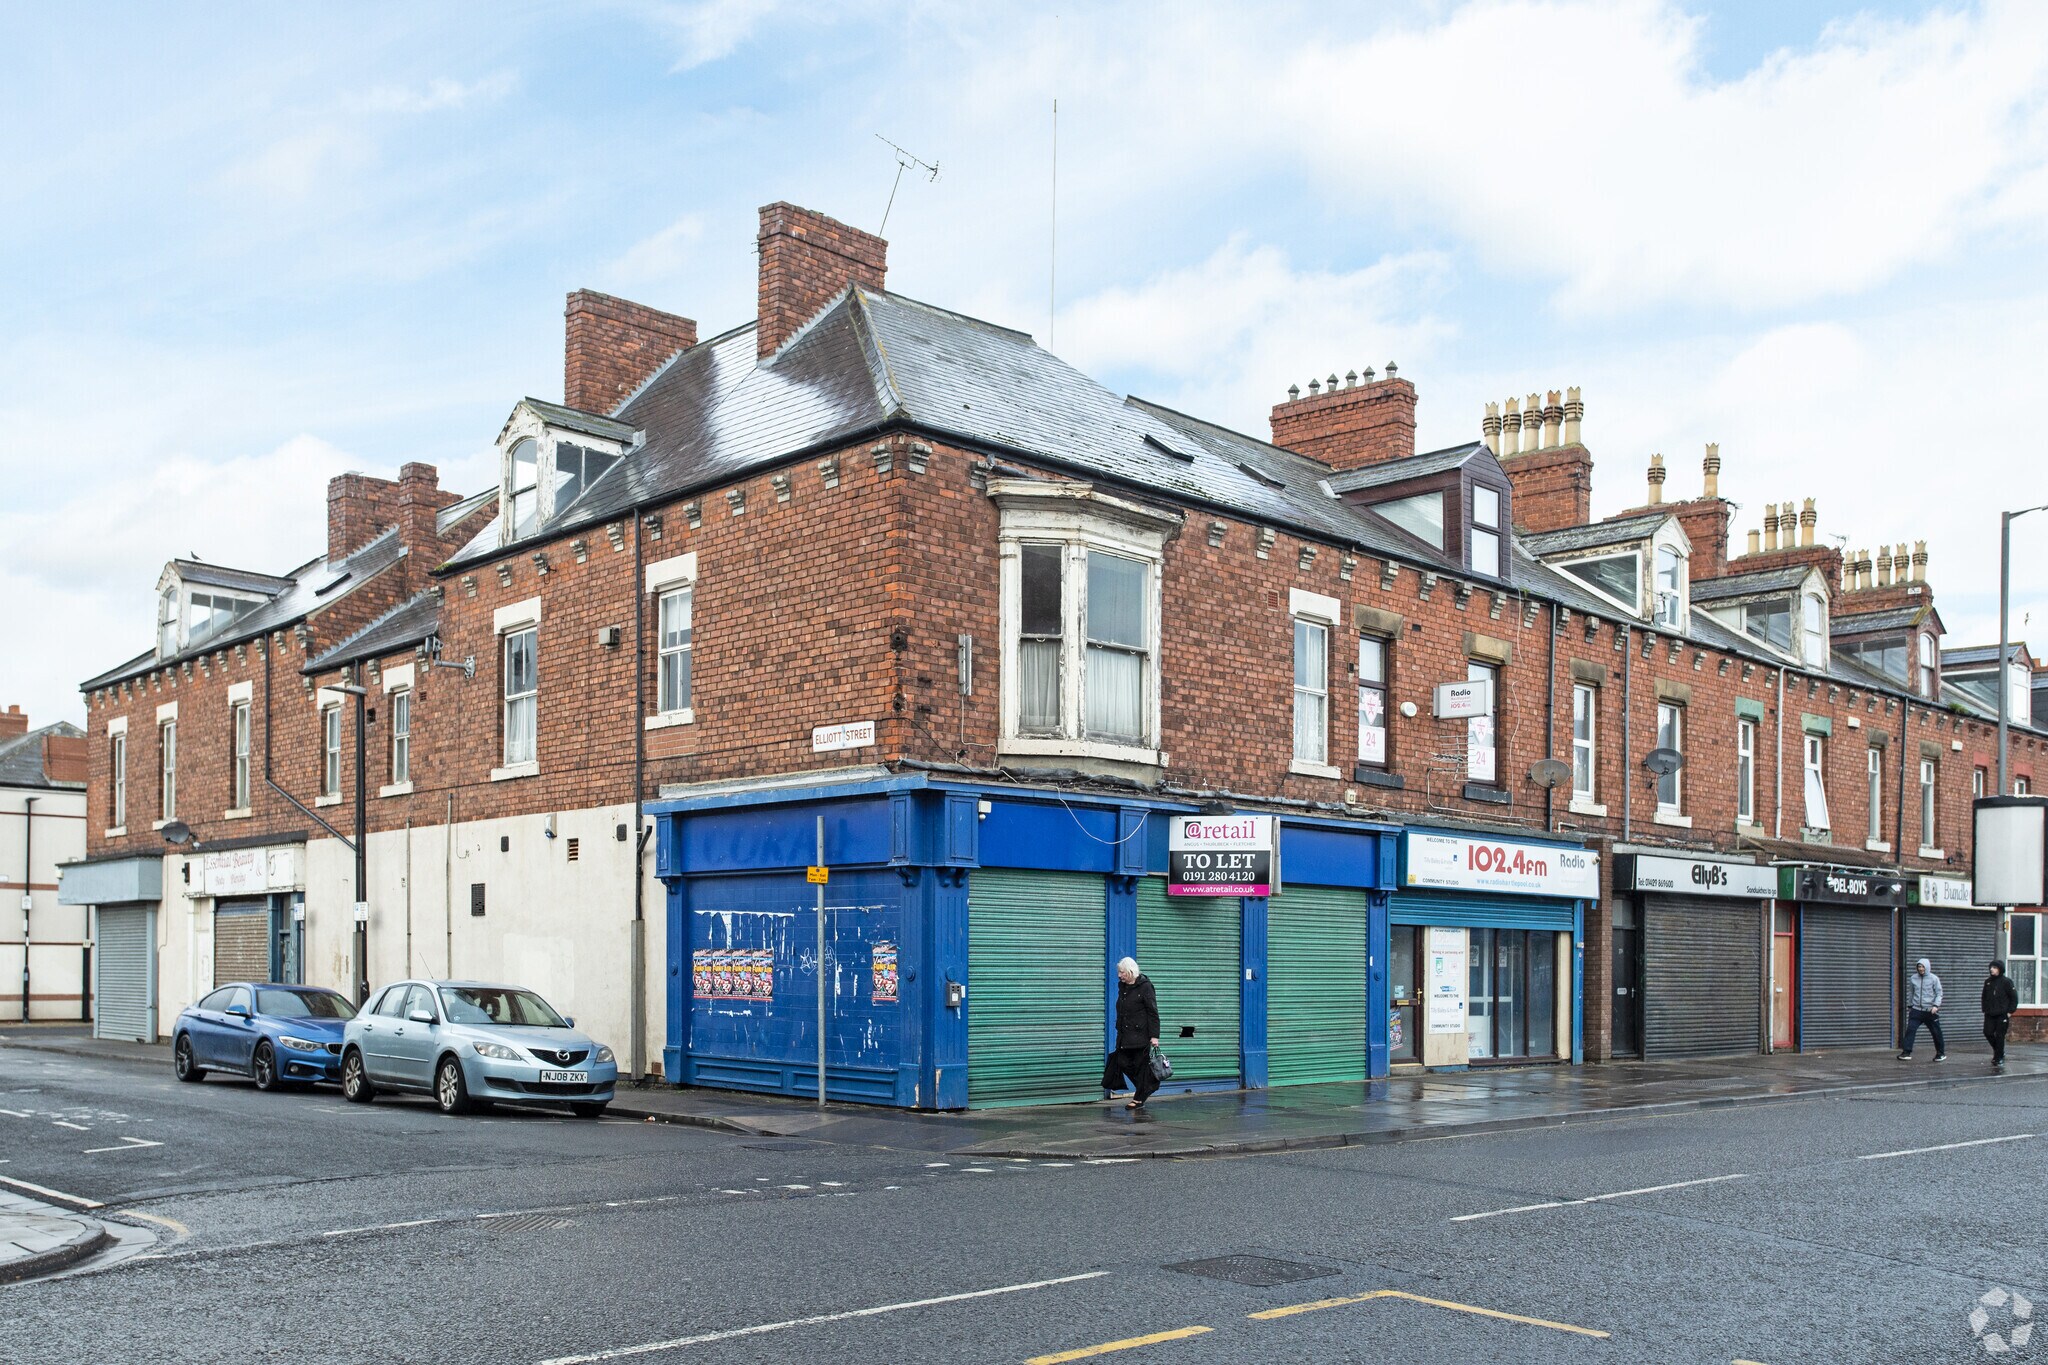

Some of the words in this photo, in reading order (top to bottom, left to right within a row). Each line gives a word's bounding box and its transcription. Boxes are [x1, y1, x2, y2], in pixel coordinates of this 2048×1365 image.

[1450, 689, 1471, 697] Radio
[815, 731, 842, 745] ELLIOTT
[845, 727, 872, 741] STREET
[1366, 731, 1376, 747] 24
[1476, 751, 1486, 766] 24
[1184, 820, 1256, 839] @retail
[1183, 854, 1211, 869] TO
[1216, 854, 1256, 869] LET
[1468, 844, 1547, 877] 102.4fm
[1560, 853, 1586, 869] Radio
[1183, 871, 1205, 881] 0191
[1208, 871, 1228, 881] 280
[1228, 871, 1255, 881] 4120
[1476, 878, 1541, 888] www.radiohartlepool.co.uk
[1645, 878, 1657, 887] 01429
[1833, 878, 1867, 895] DEL-BOYS
[1944, 882, 1969, 901] Bundle
[545, 1072, 568, 1081] NJ08
[570, 1072, 584, 1081] ZKX
